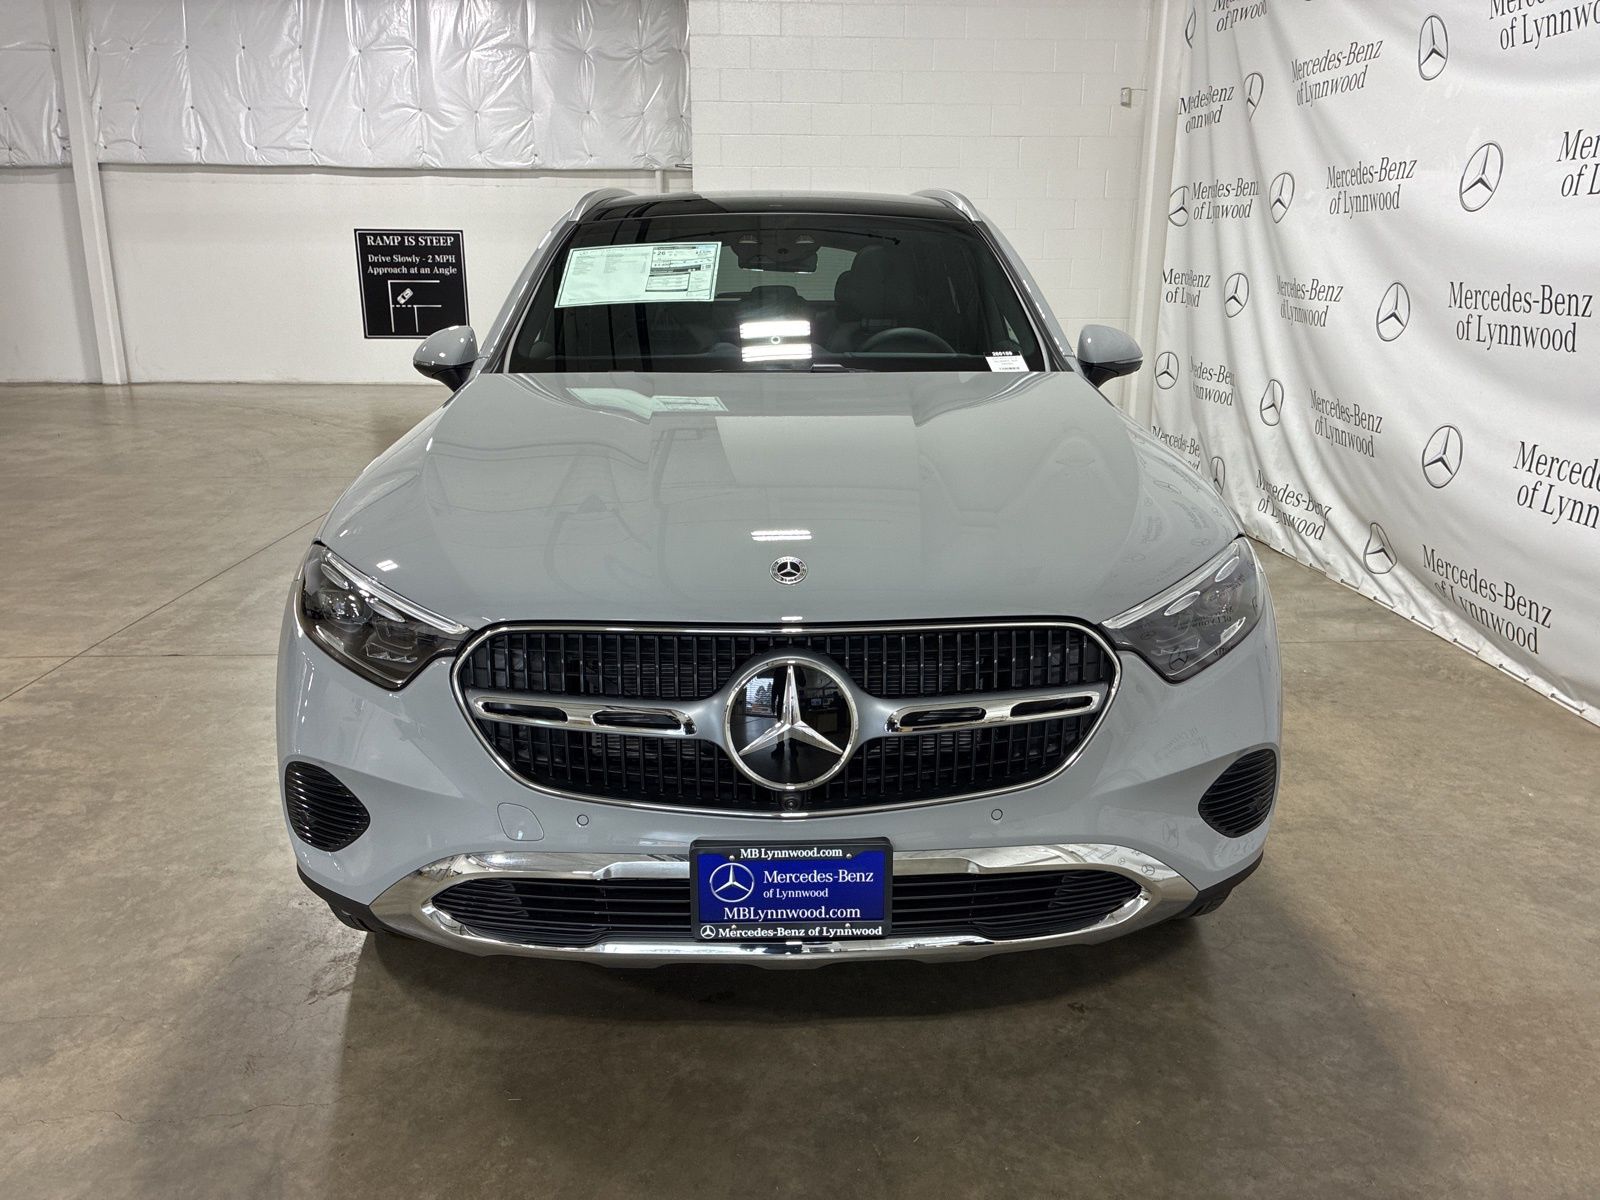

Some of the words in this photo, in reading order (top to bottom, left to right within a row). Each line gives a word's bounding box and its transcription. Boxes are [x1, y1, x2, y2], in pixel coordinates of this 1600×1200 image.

[1500, 16, 1517, 50] of
[1291, 40, 1383, 83] Mercedes-Benz
[1296, 82, 1304, 106] of
[1304, 64, 1368, 107] Lynnwood
[1326, 157, 1417, 190] Mercedes-Benz
[1561, 164, 1588, 197] of
[1193, 201, 1206, 220] of
[1329, 190, 1342, 215] of
[1342, 184, 1401, 220] Lynnwood
[366, 235, 401, 246] RAMP
[404, 236, 416, 246] IS
[418, 236, 455, 246] STEEP
[367, 265, 408, 275] Approach
[410, 266, 418, 274] at
[432, 266, 458, 275] Angle
[368, 254, 391, 263] Drive
[393, 254, 421, 264] Slowly
[427, 255, 433, 263] 2
[435, 255, 456, 263] MPH
[1166, 286, 1180, 303] of
[1448, 281, 1594, 318] Mercedes-Benz
[1456, 313, 1473, 341] of
[1476, 315, 1577, 353] Lynnwood
[1310, 388, 1383, 434] Mercedes-Benz
[1315, 416, 1323, 436] of
[1324, 418, 1375, 458] Lynnwood
[1517, 480, 1542, 509] of
[1422, 544, 1552, 628] Mercedes-Benz
[1449, 584, 1539, 654] Lynnwood
[740, 848, 760, 859] MB
[761, 847, 843, 860] Lynnwood.com
[763, 869, 874, 883] Mercedes-Benz
[763, 888, 774, 898] of
[776, 888, 829, 900] Lynnwood
[724, 906, 861, 922] MBLynnwood.com
[718, 926, 805, 938] Mercedes-Benz
[808, 926, 821, 937] of
[822, 926, 882, 937] Lynnwood
